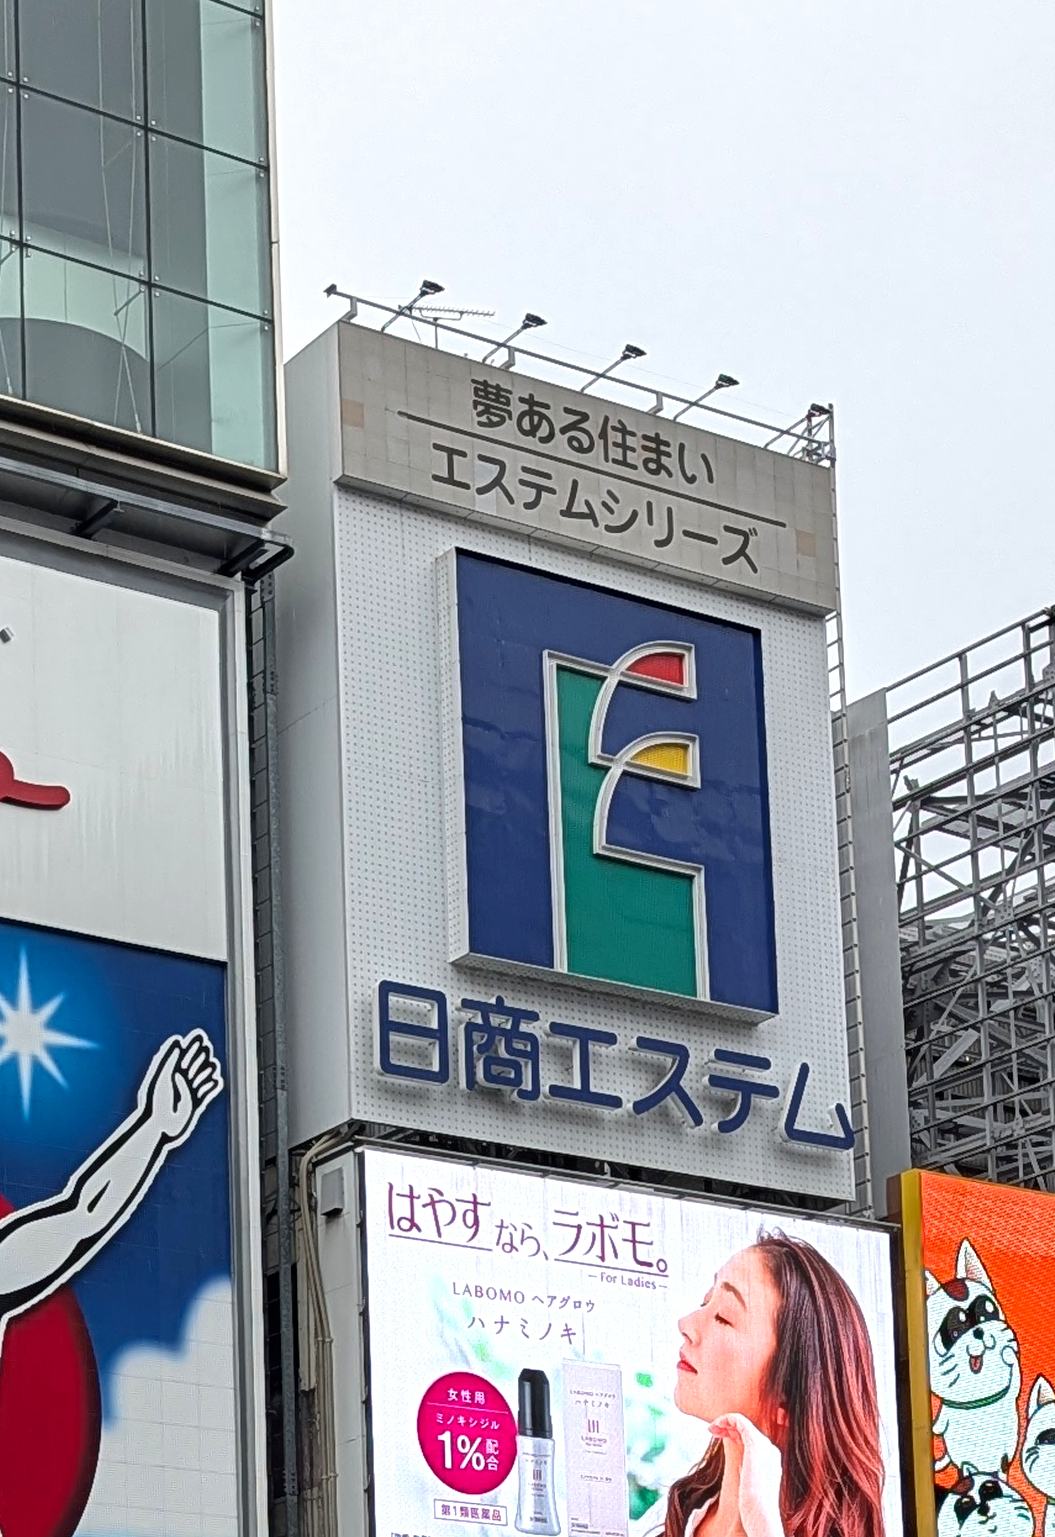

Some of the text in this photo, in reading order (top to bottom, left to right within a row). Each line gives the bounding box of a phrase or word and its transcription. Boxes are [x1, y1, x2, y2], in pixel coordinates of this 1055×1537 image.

[471, 379, 714, 485] 夢ある住まい
[431, 442, 760, 574] エステムシリーズ
[374, 979, 856, 1151] 日商エステム
[452, 1282, 595, 1312] LABOMO ヘアグロウ
[620, 1274, 657, 1290] Ladies
[467, 1315, 577, 1345] ハナミノキ
[447, 1388, 485, 1405] 女性用
[435, 1413, 500, 1430] ミノキシジル
